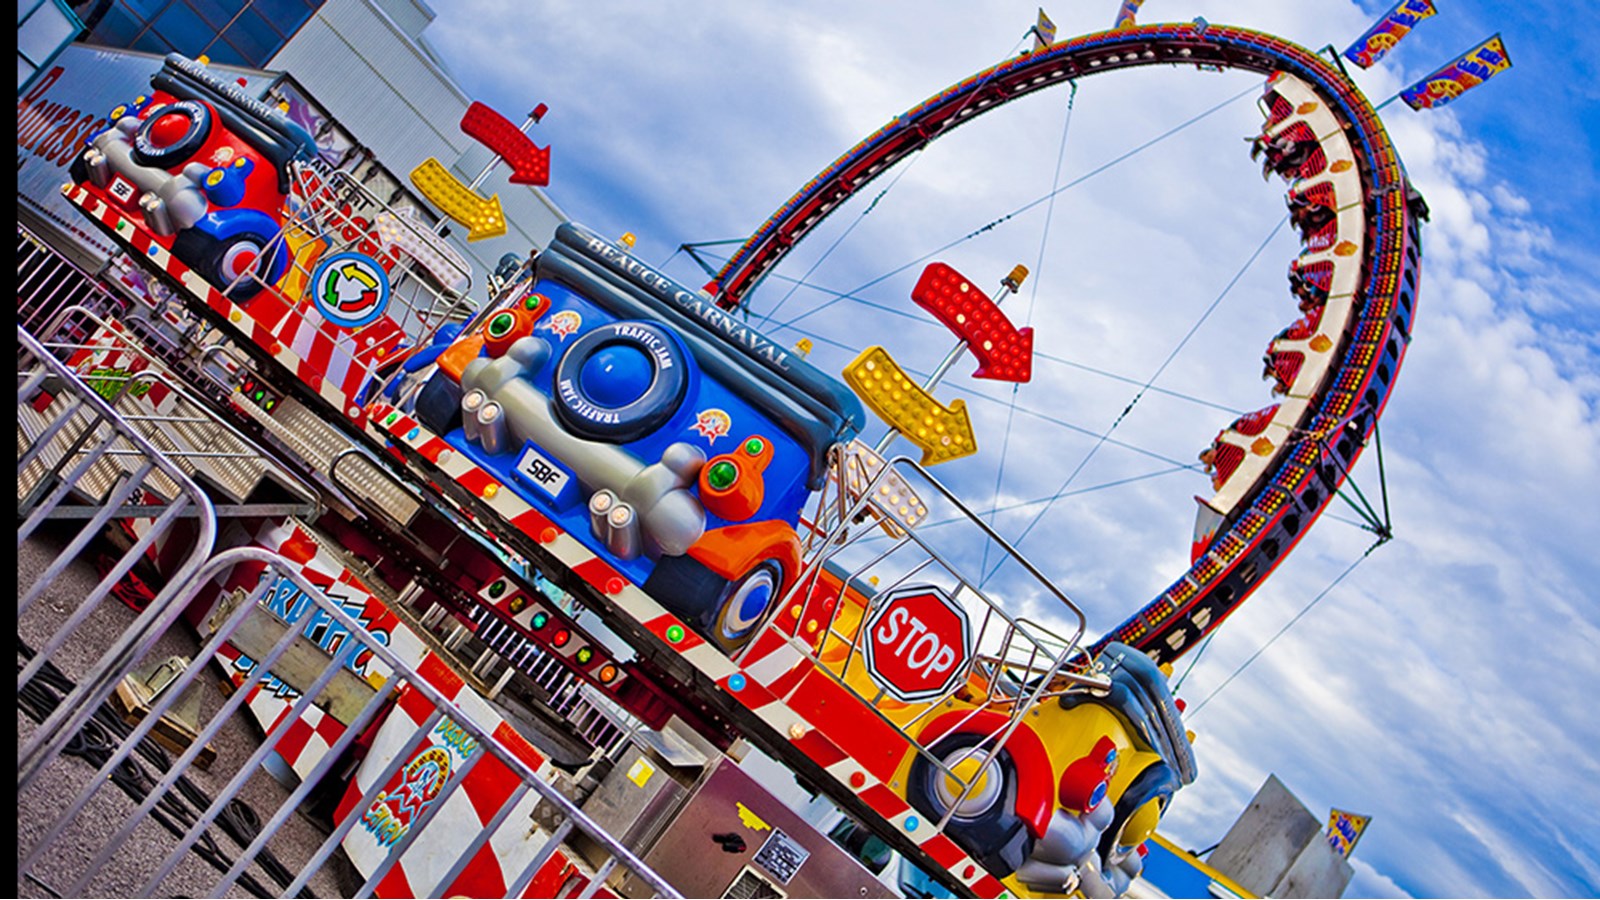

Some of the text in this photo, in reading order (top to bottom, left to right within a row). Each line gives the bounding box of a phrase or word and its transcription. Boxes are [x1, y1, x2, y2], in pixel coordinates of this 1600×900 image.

[17, 65, 107, 167] Bourass
[218, 83, 273, 118] CARNAVAL
[311, 157, 375, 211] ANSPORT
[586, 237, 790, 371] BEAUCE CARNAVAL
[613, 325, 673, 369] TRAFFIC JAM
[560, 379, 620, 424] TRAFFIC JAM
[526, 458, 561, 485] SBF
[877, 606, 955, 680] STOP
